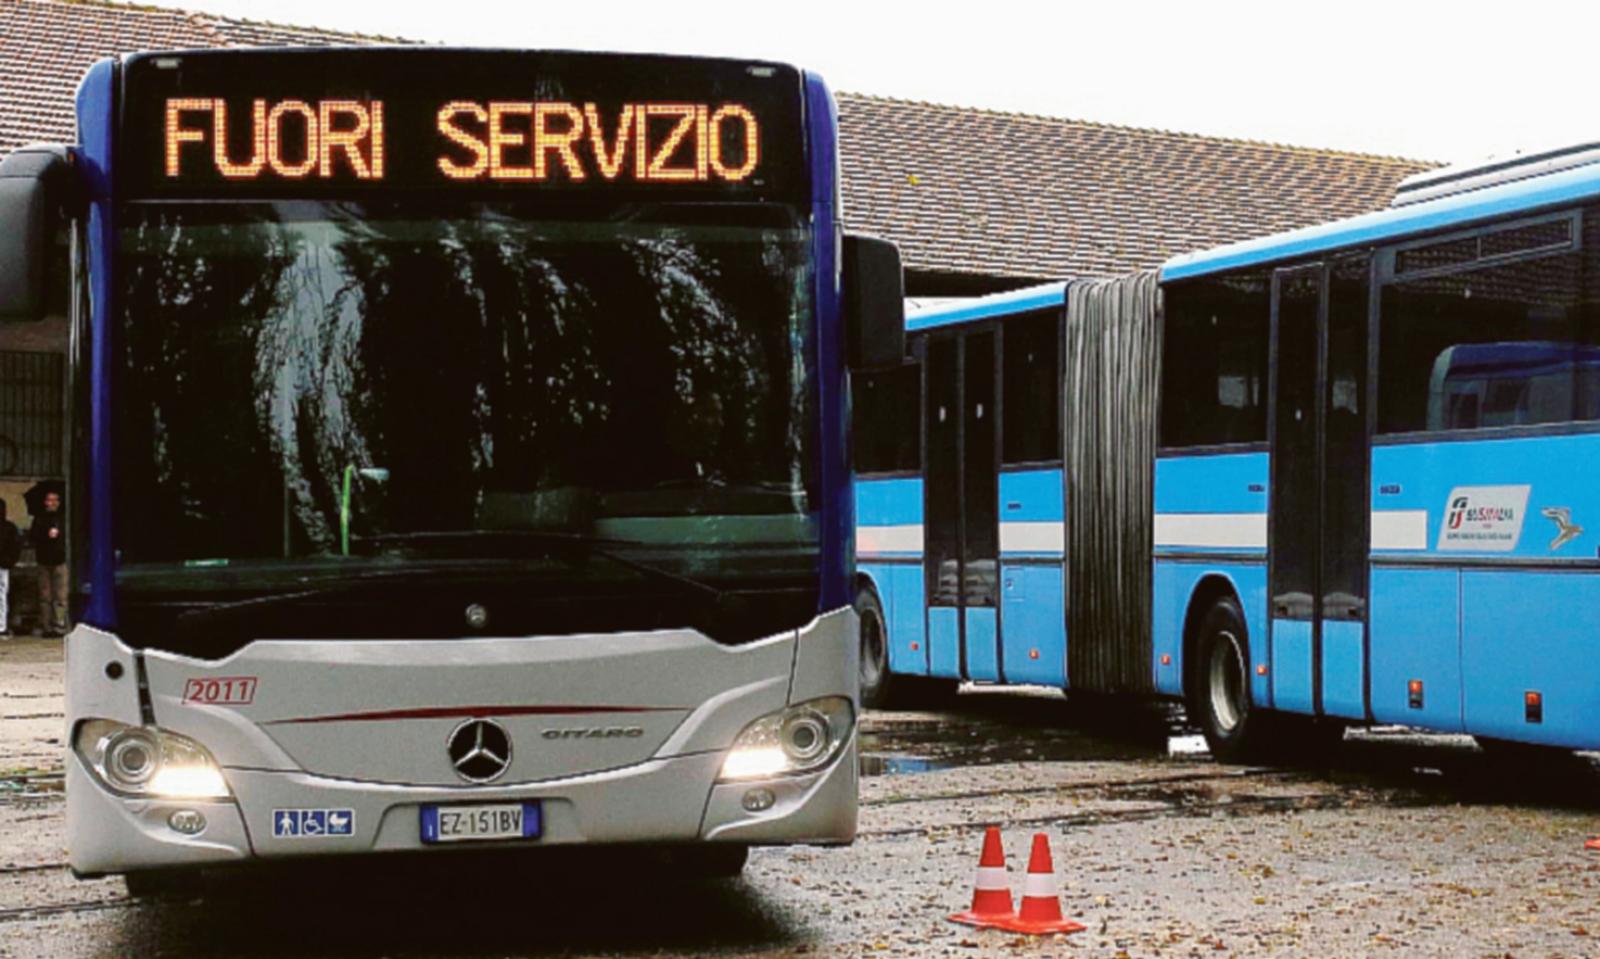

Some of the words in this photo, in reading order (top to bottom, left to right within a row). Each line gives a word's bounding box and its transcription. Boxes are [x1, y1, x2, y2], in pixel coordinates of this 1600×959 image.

[165, 98, 384, 178] FUORI
[437, 101, 758, 181] SERVIZIO
[190, 680, 249, 701] 2011
[440, 810, 522, 835] EZ-151BV
